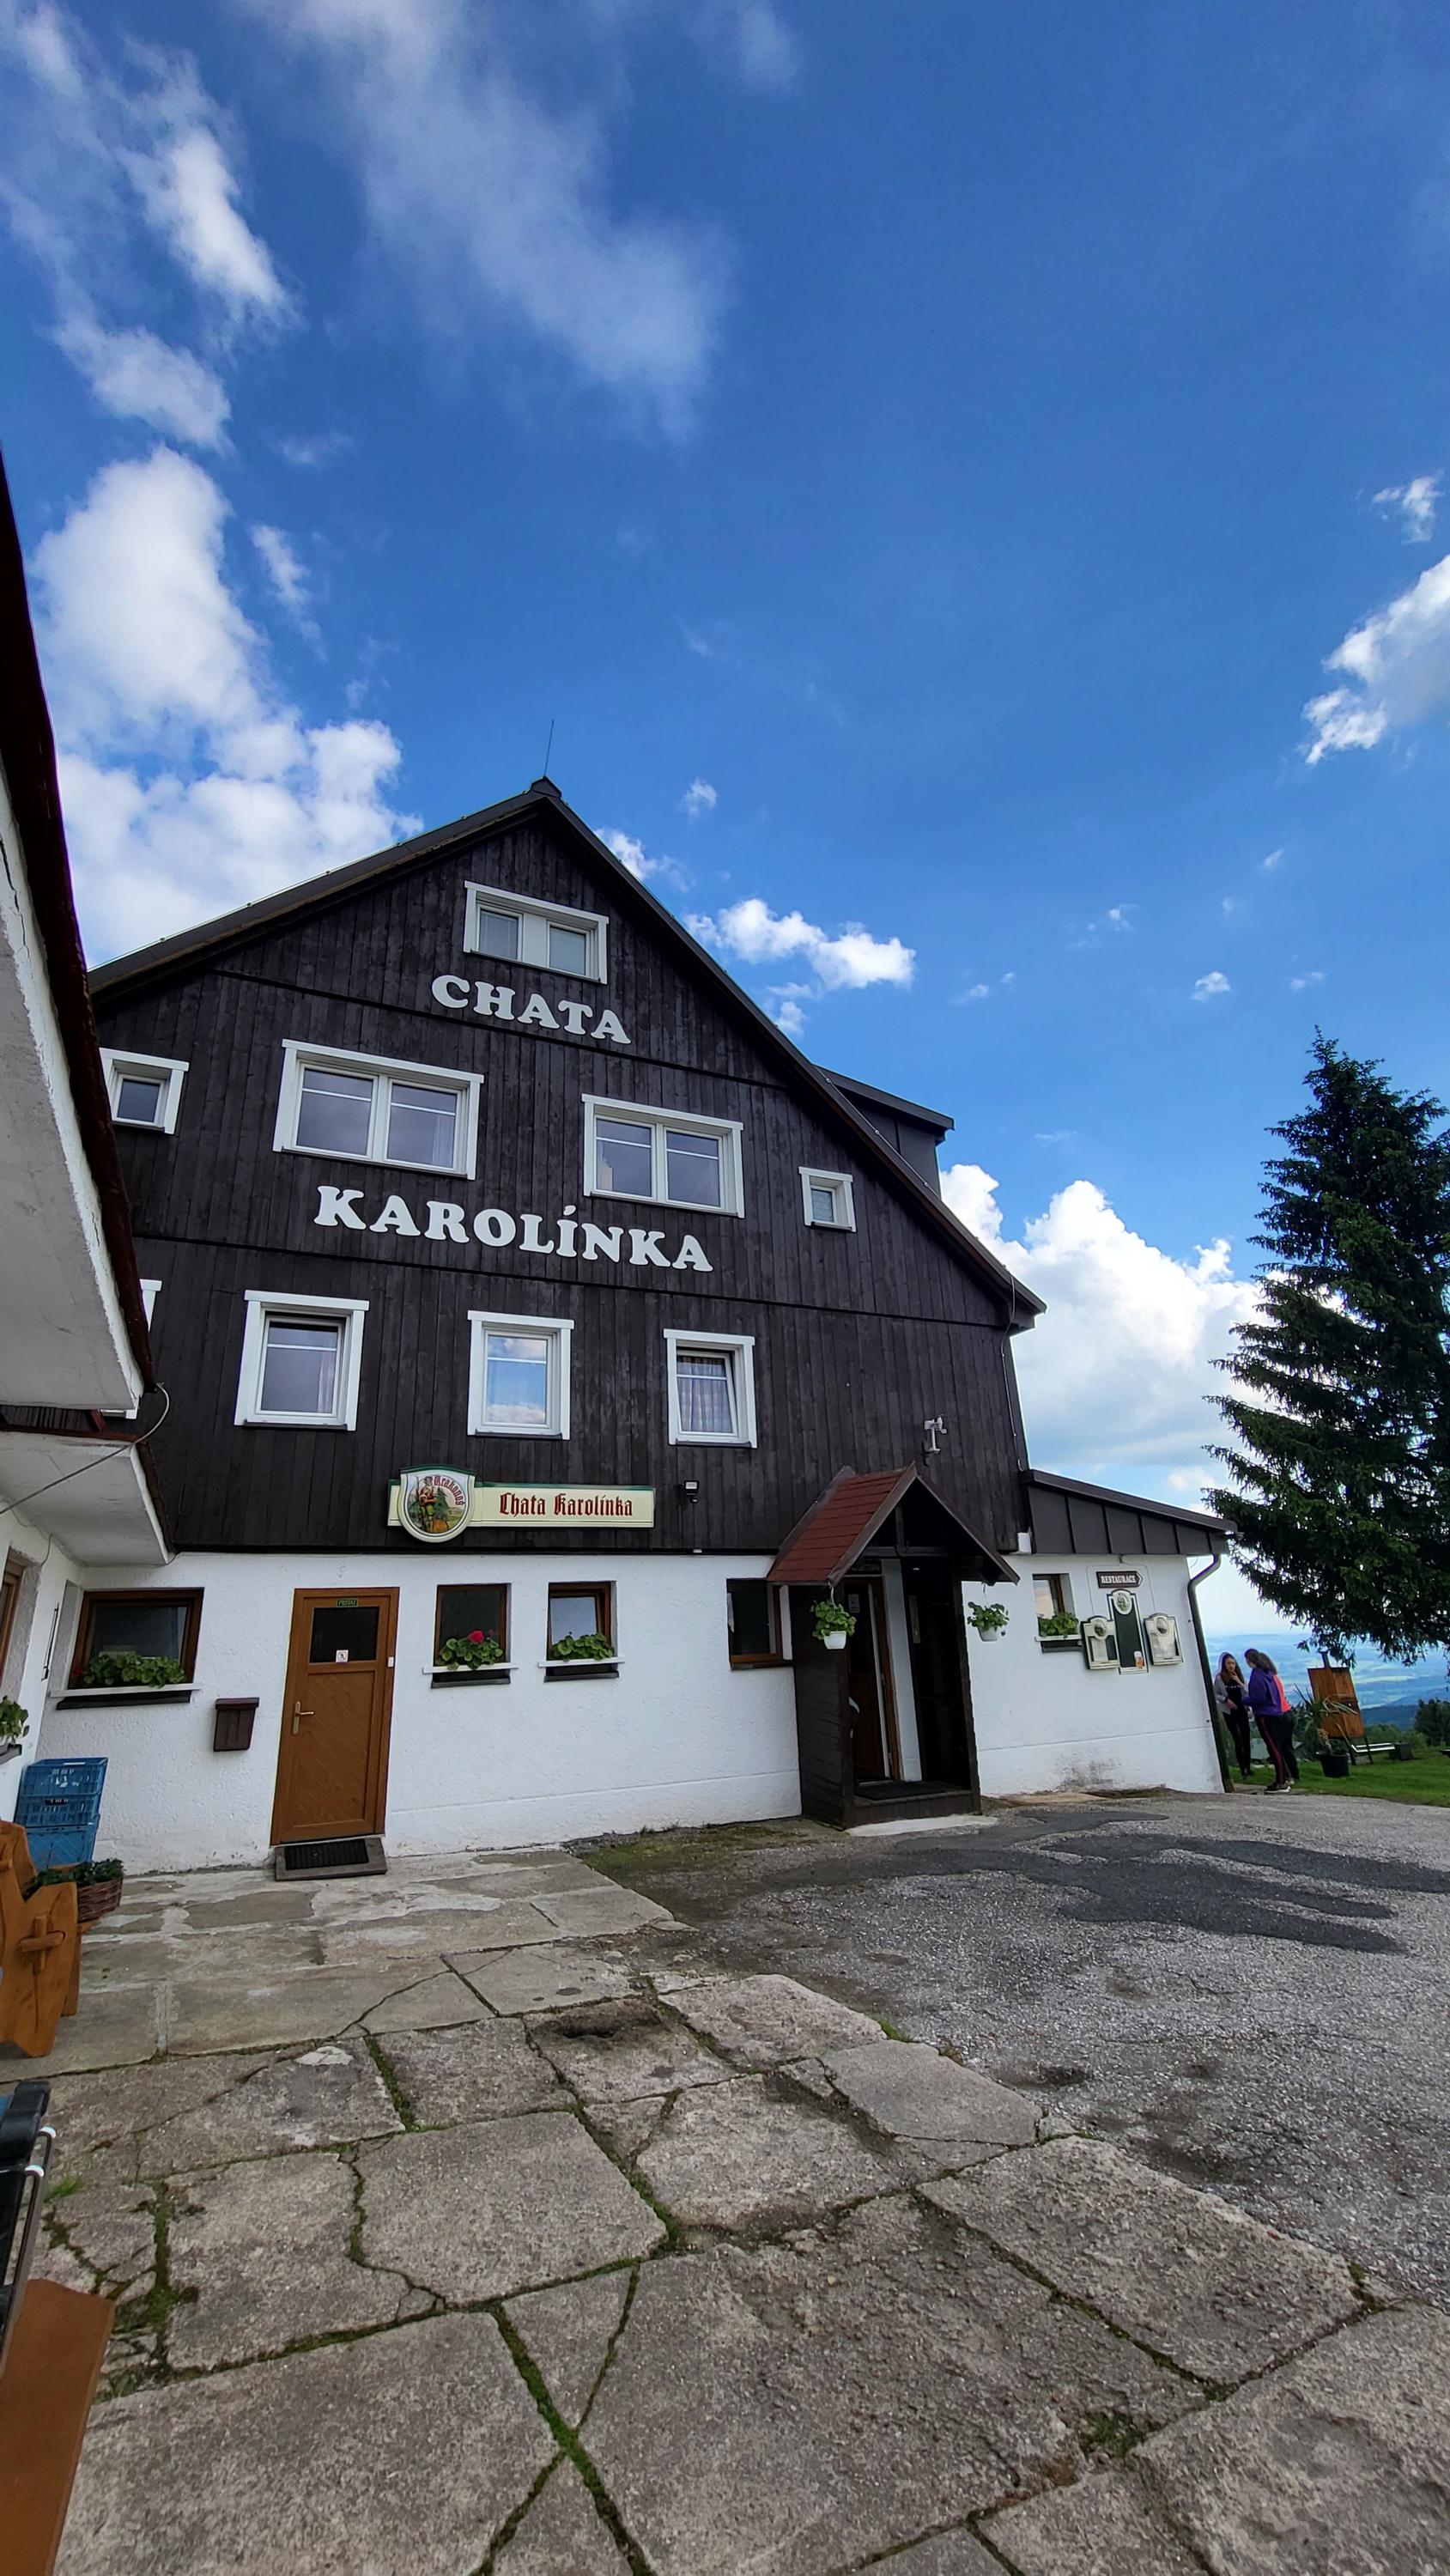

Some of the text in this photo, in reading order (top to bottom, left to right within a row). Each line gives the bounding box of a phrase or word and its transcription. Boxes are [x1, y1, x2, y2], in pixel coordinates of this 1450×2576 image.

[432, 975, 631, 1044] CHATA
[313, 1185, 713, 1272] KAROLÍNKA
[499, 1492, 633, 1517] Chata Karolínka
[1101, 1575, 1137, 1584] RESTAURACE
